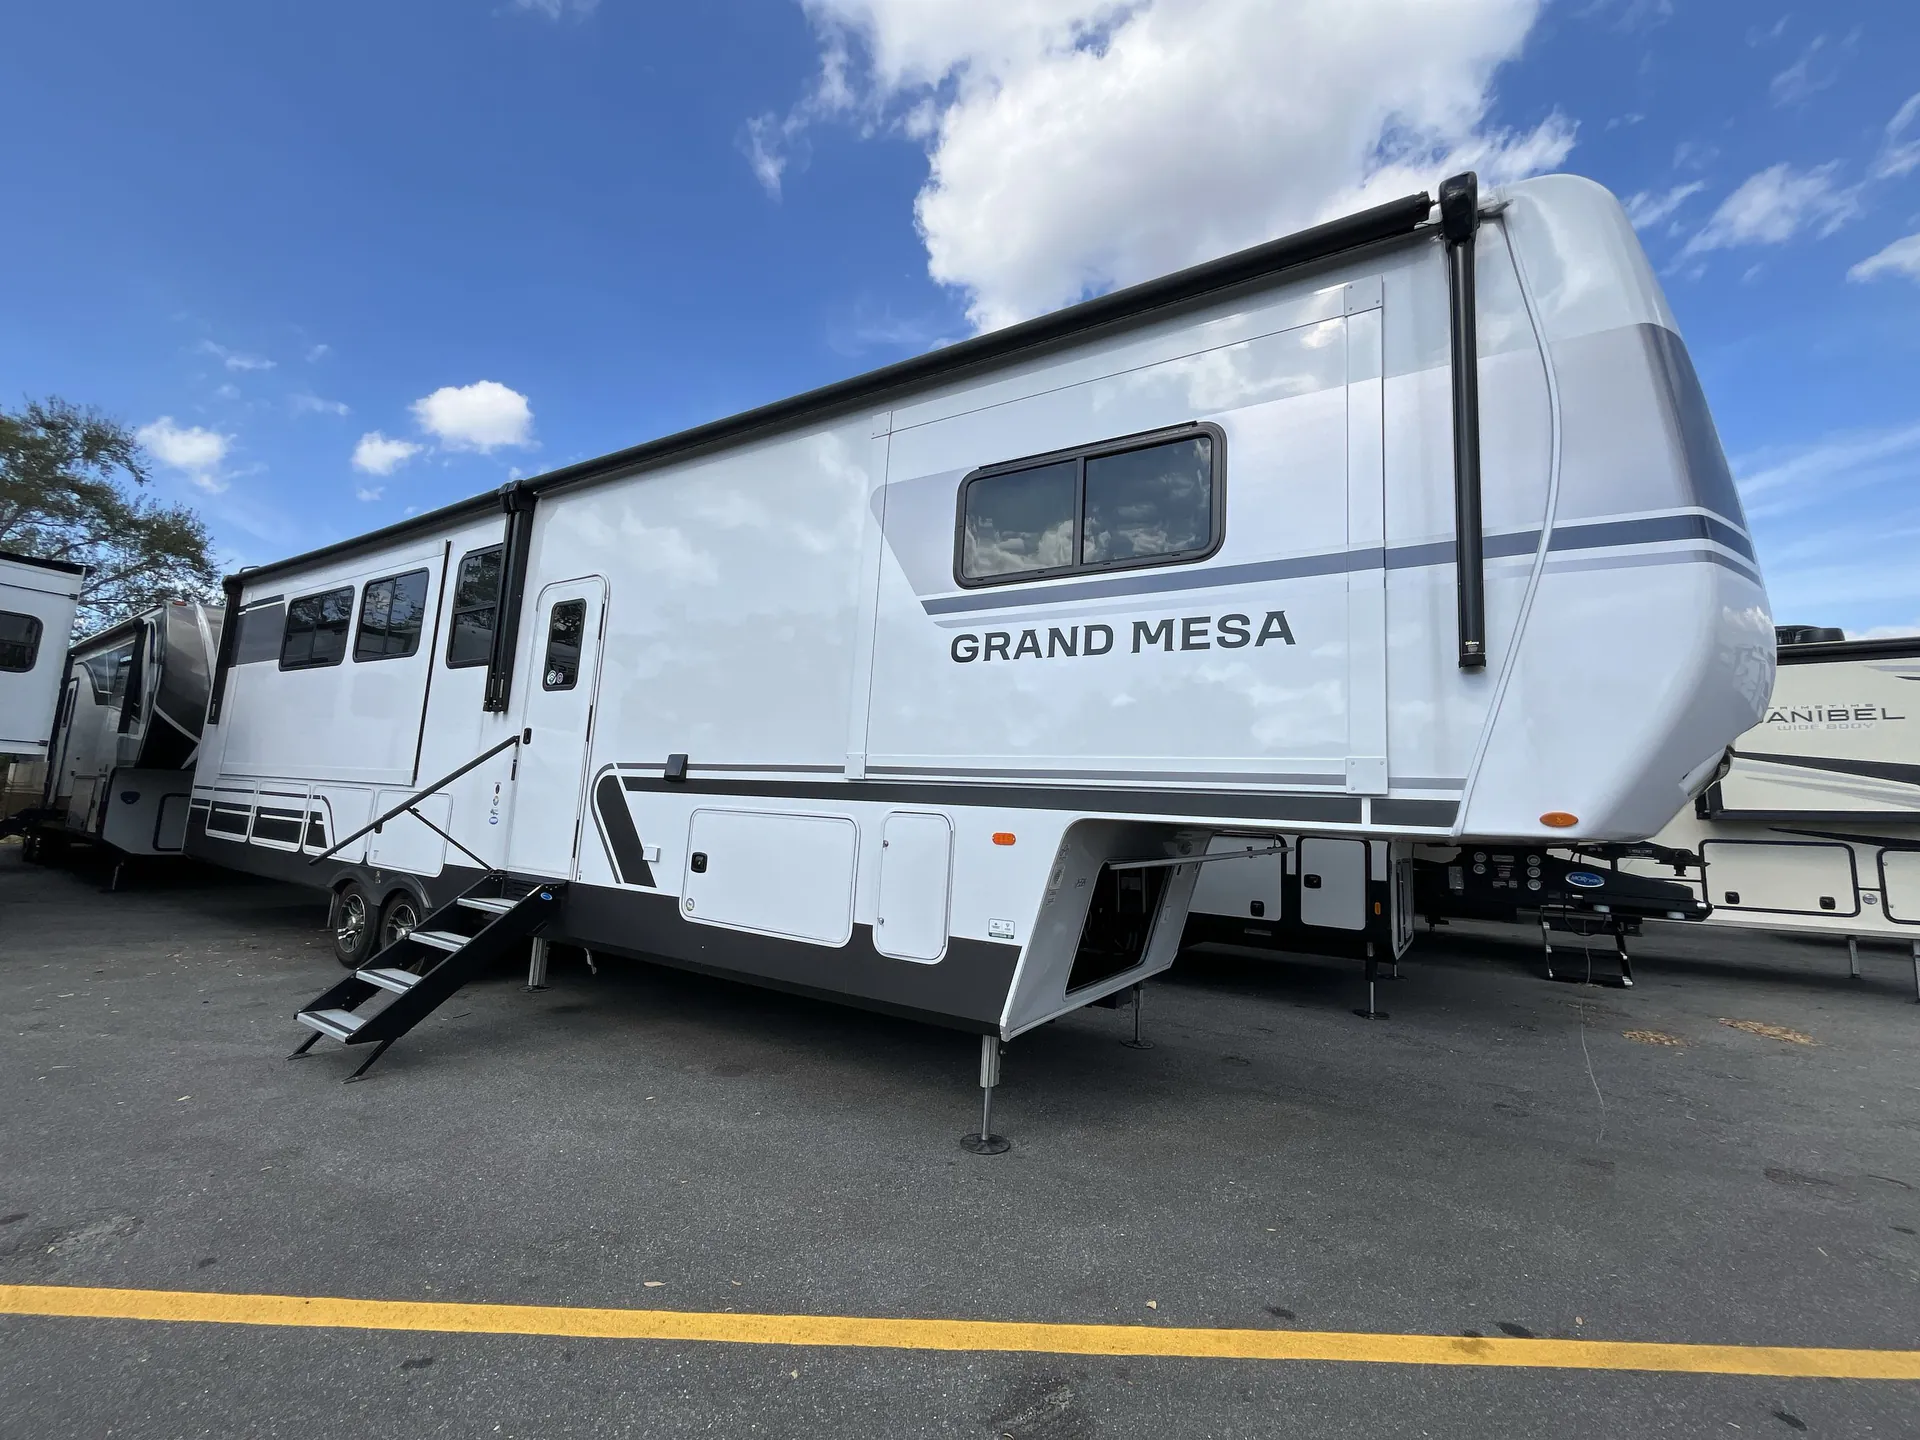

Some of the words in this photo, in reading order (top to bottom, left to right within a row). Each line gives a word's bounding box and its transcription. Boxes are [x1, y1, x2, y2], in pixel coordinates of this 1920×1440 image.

[950, 623, 1114, 663] GRAND
[1130, 610, 1296, 654] MESA
[1766, 708, 1905, 723] ANIBEL
[1777, 723, 1820, 731] WIDE
[1826, 722, 1874, 730] BODY
